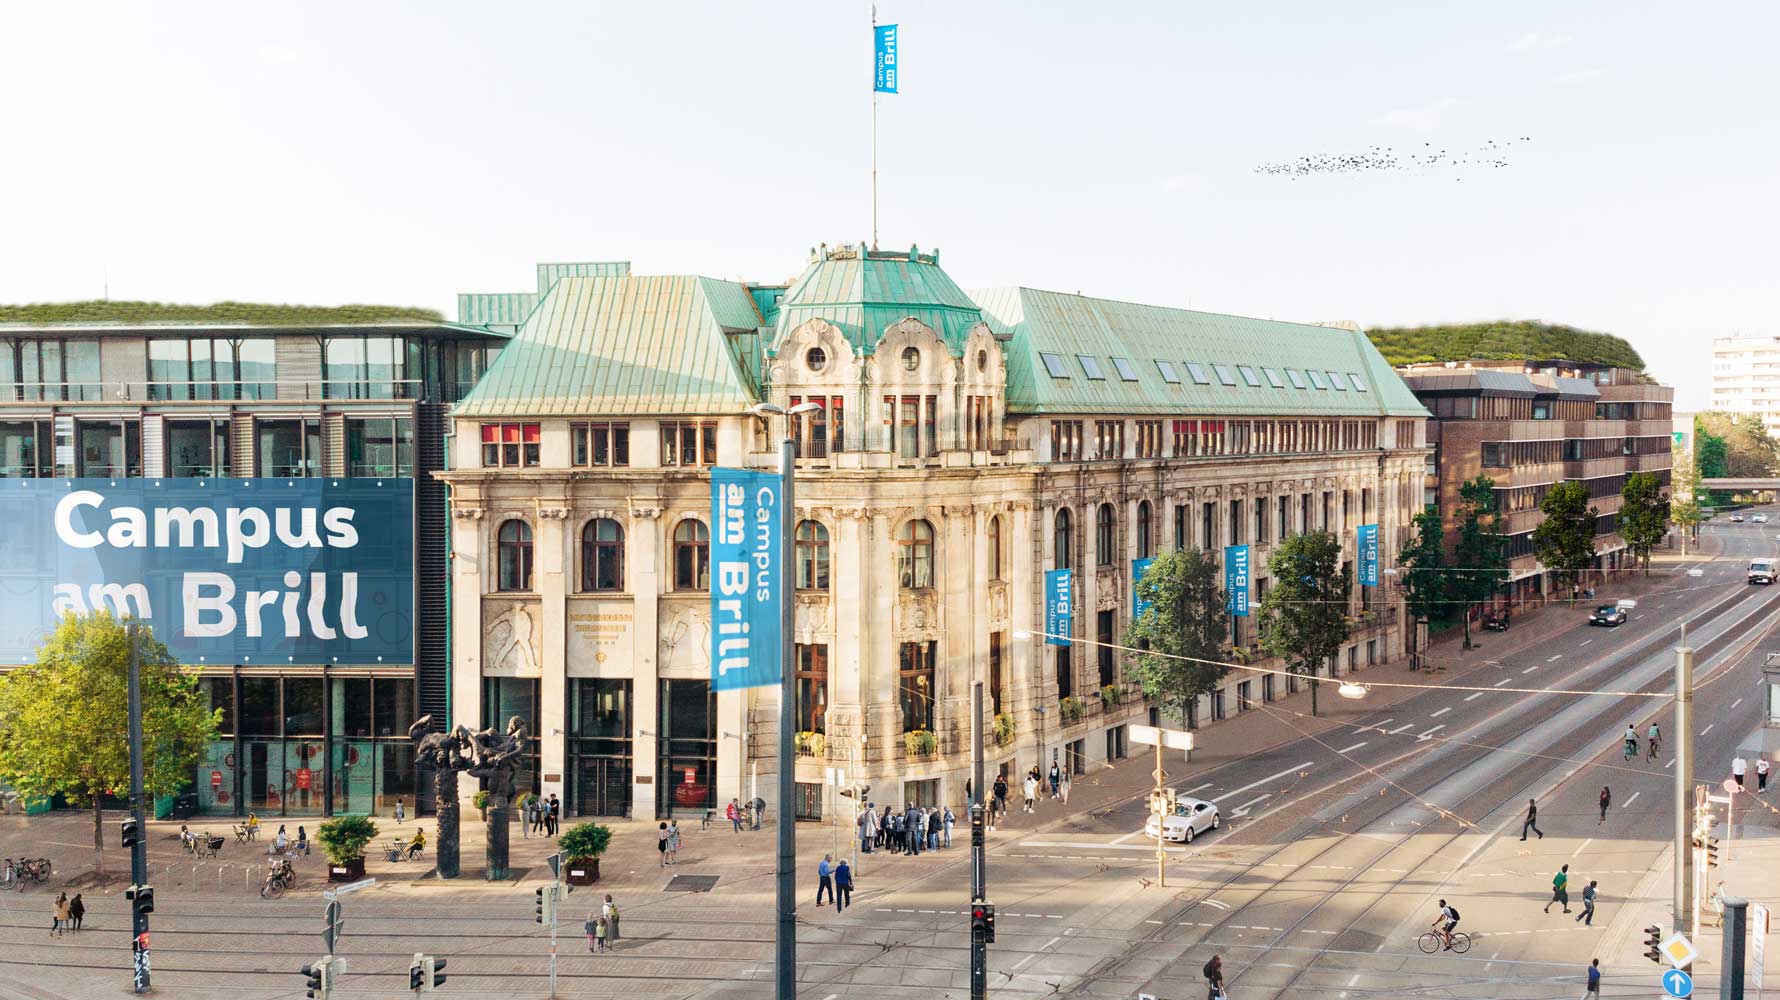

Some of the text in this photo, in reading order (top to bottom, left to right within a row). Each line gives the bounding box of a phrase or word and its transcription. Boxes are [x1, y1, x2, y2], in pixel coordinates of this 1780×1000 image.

[877, 51, 885, 88] Campus
[885, 28, 895, 88] am Brill
[54, 490, 359, 563] Campus
[752, 486, 774, 602] Campus
[1366, 527, 1376, 582] am Brill
[52, 571, 368, 640] am Brill
[719, 483, 749, 676] am Brill
[1057, 574, 1068, 613] Brill
[1235, 549, 1246, 611] am Brill
